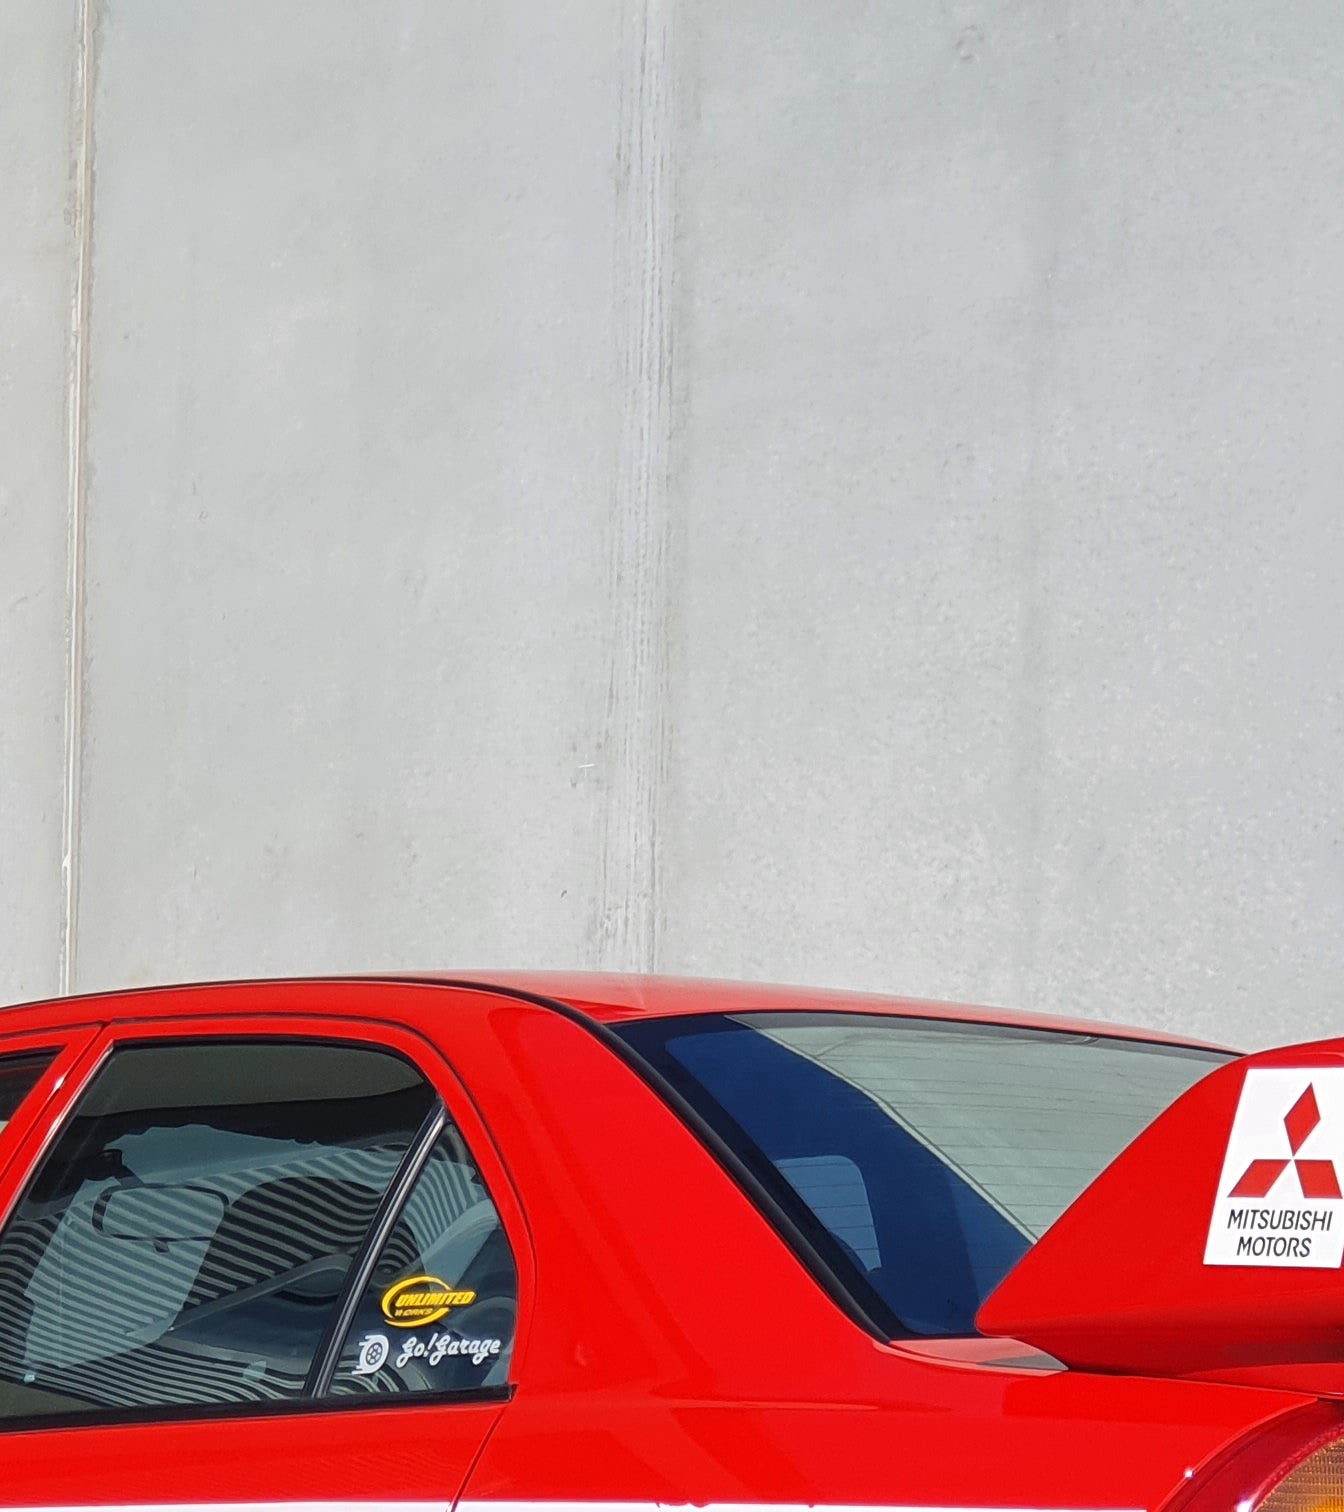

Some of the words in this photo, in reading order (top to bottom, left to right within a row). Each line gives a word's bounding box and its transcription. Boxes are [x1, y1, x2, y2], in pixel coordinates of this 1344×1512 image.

[1227, 1209, 1333, 1231] MITSUBISHI
[1236, 1236, 1312, 1258] MOTORS
[395, 1291, 475, 1307] UNLIMITED
